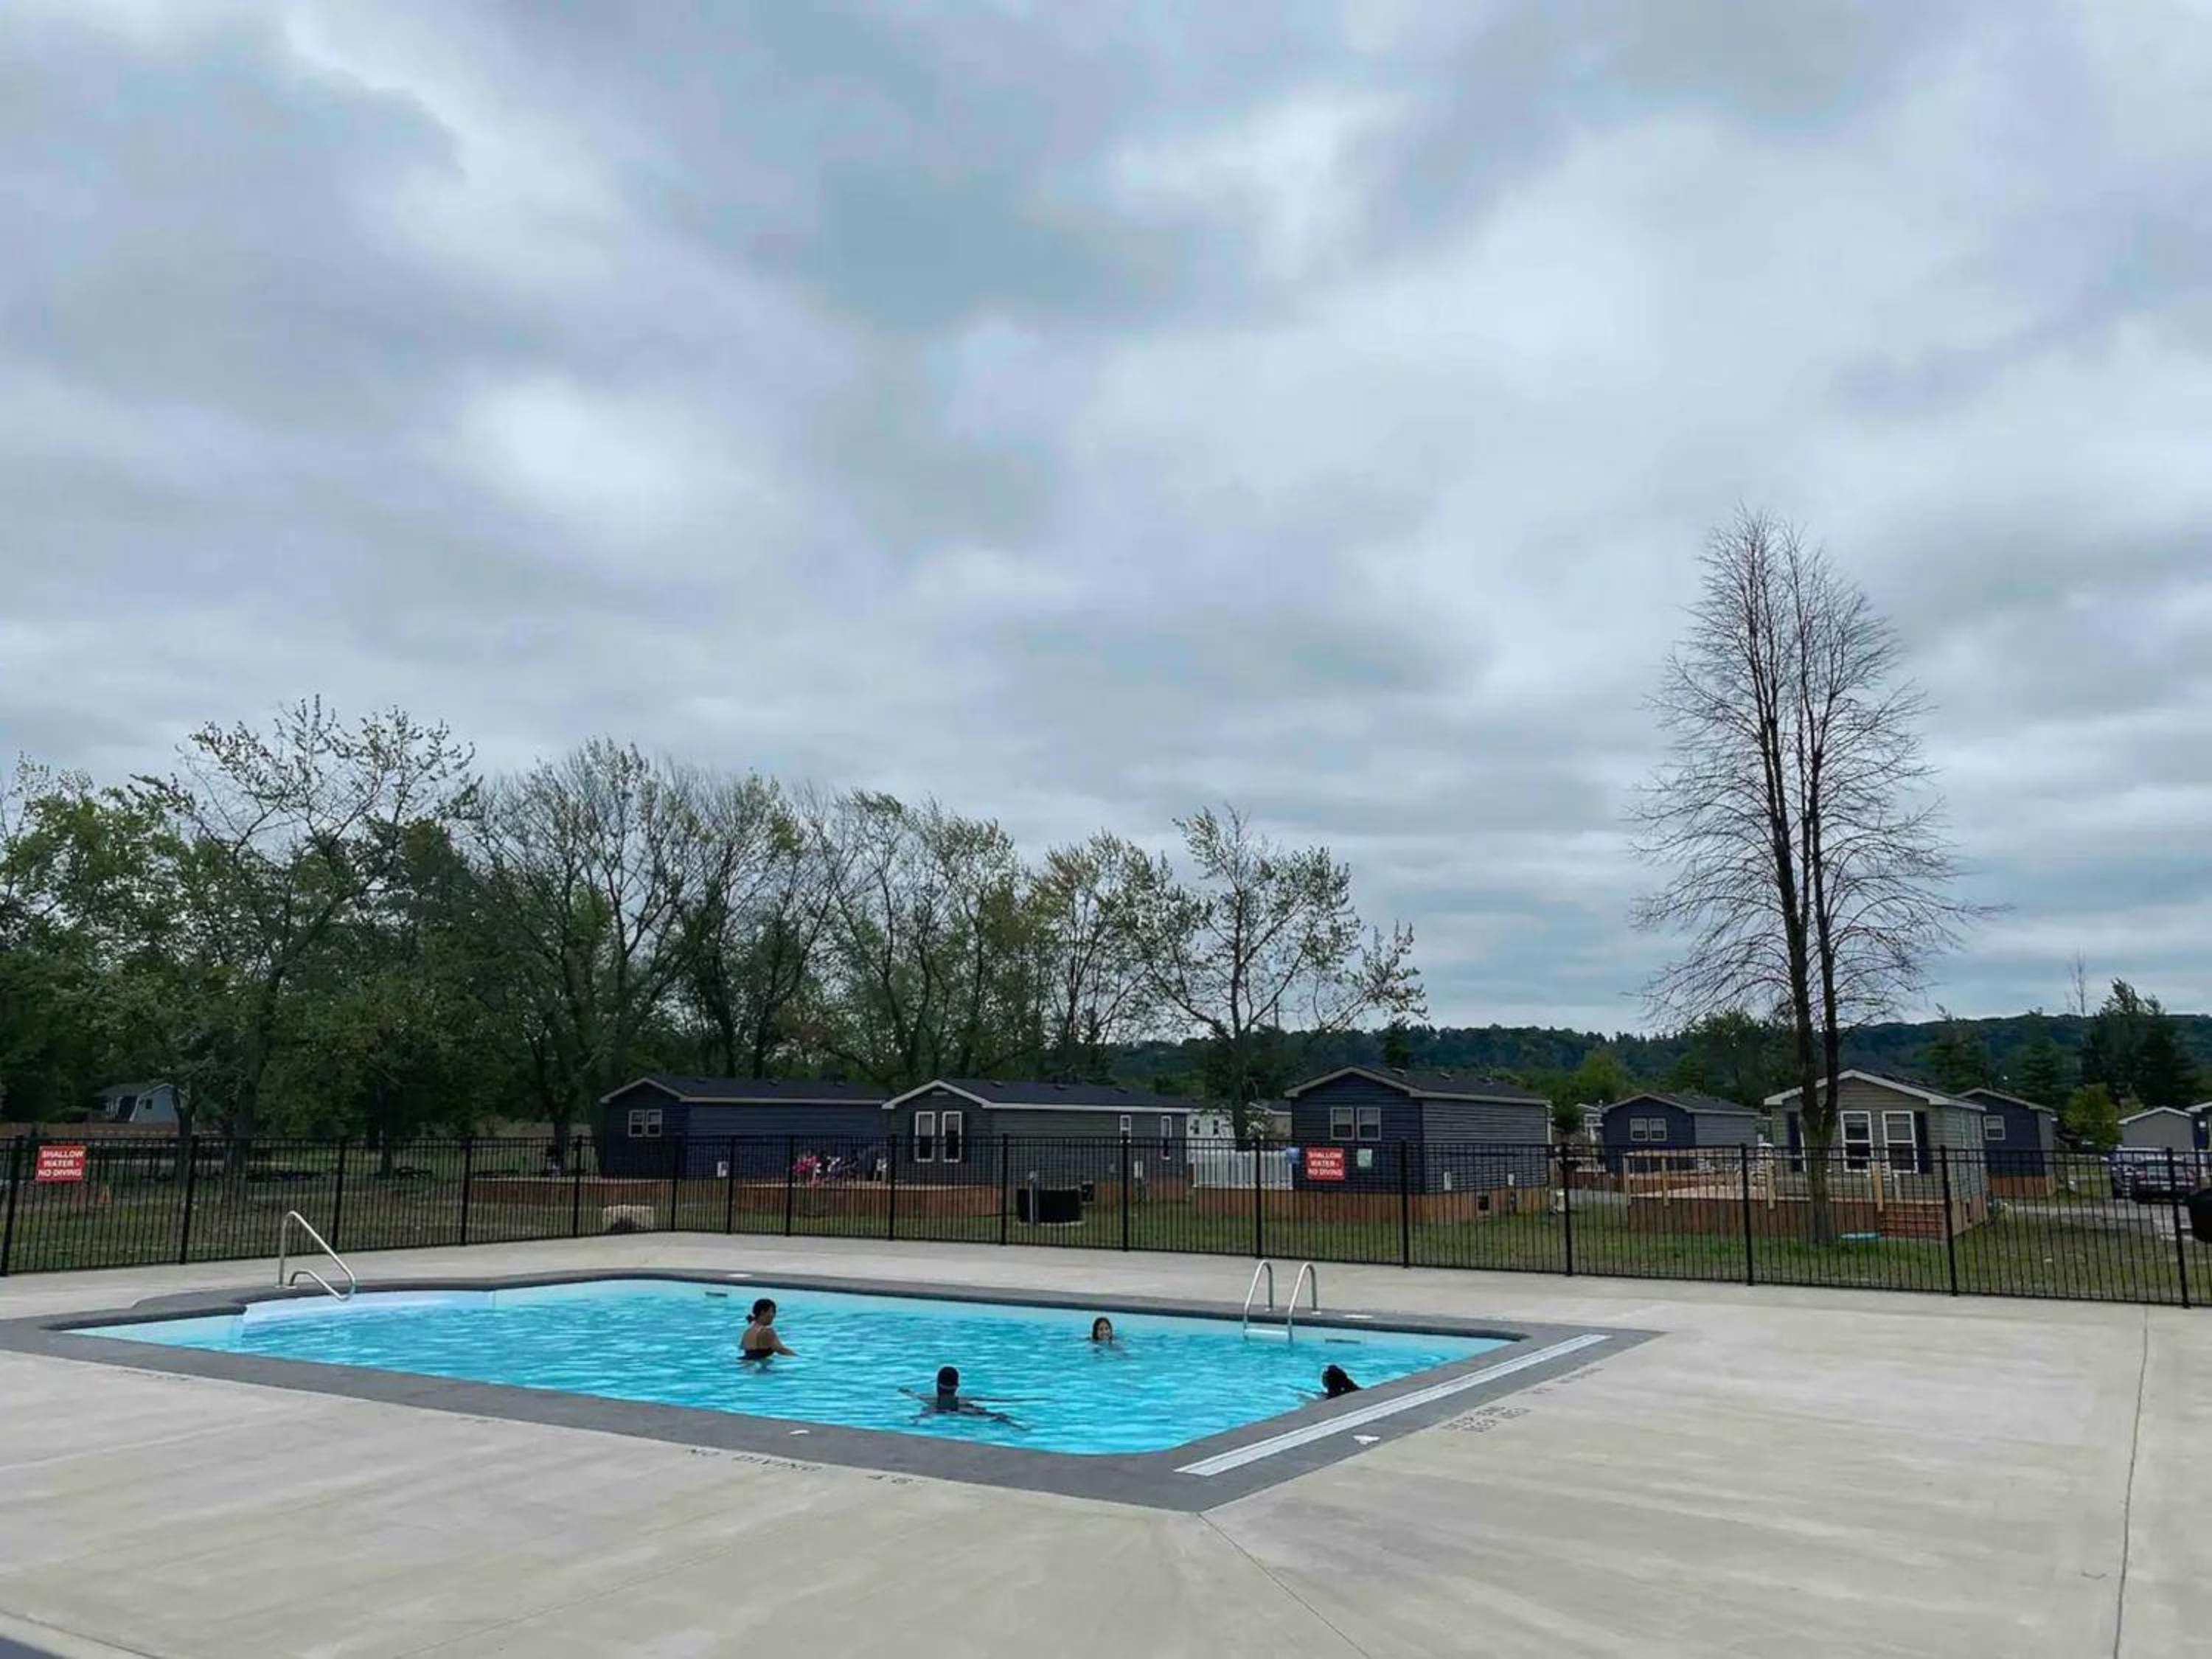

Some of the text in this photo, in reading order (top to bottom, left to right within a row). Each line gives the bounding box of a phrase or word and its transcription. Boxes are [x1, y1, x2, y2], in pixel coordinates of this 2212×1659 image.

[41, 1150, 83, 1158] SHALLOW
[44, 1159, 74, 1167] WATER
[38, 1169, 81, 1177] NO DIVING
[1307, 1168, 1343, 1176] NO DIVING
